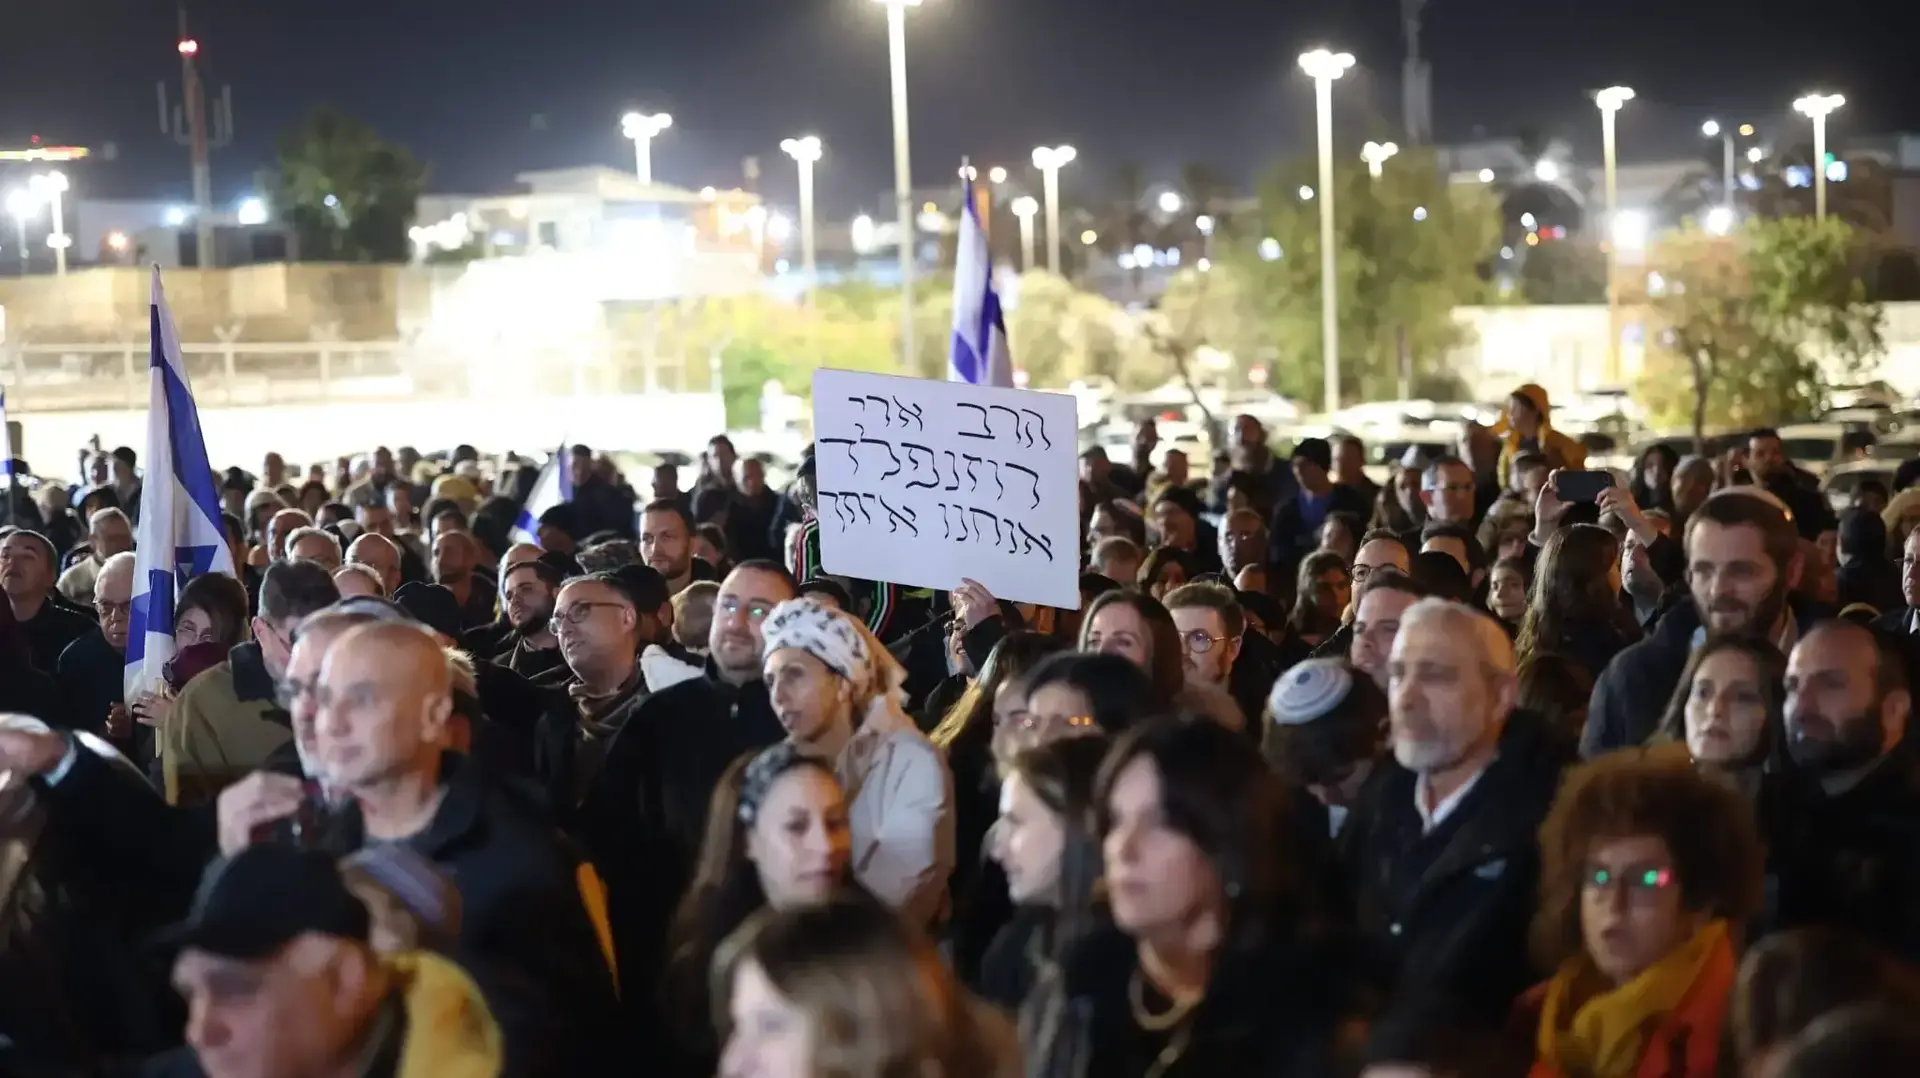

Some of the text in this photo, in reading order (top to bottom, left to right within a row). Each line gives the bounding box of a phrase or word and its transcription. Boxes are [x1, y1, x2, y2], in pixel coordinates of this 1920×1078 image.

[848, 395, 1051, 450] הרב ארי
[820, 422, 1040, 509] רוזנפלד
[938, 502, 1053, 562] אנחנו
